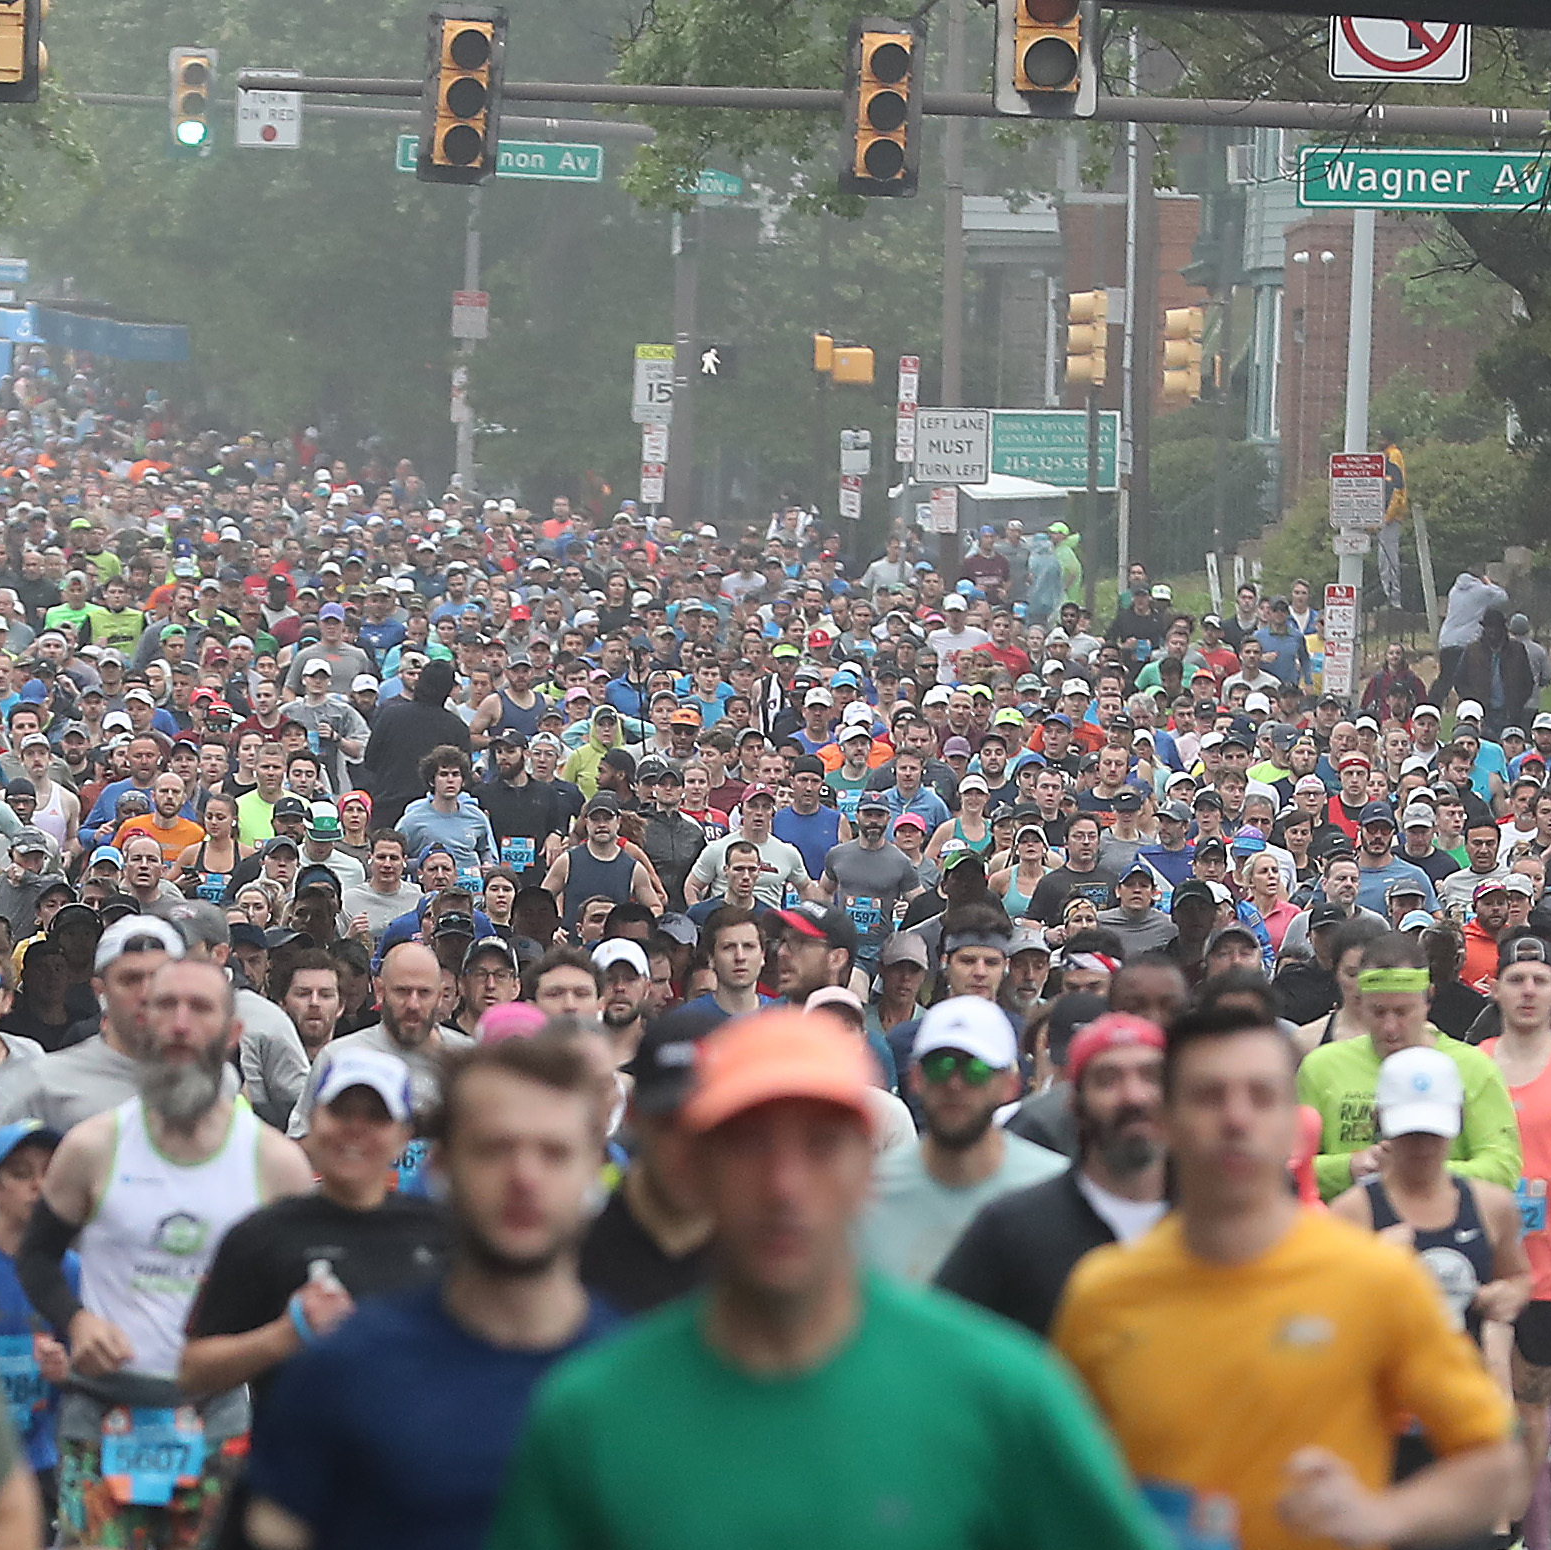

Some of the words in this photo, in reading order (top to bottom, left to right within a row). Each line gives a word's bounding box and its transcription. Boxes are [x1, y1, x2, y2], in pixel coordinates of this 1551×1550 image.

[558, 152, 592, 173] Av
[1324, 160, 1471, 200] Wagner
[1492, 163, 1544, 195] Av
[647, 382, 673, 404] 15
[919, 416, 947, 430] LEFT
[952, 417, 985, 431] LANE
[928, 439, 974, 455] MUST
[918, 463, 951, 476] TURN
[956, 463, 983, 477] LEFT
[1003, 455, 1106, 472] 215-329-552
[504, 851, 530, 862] 6327
